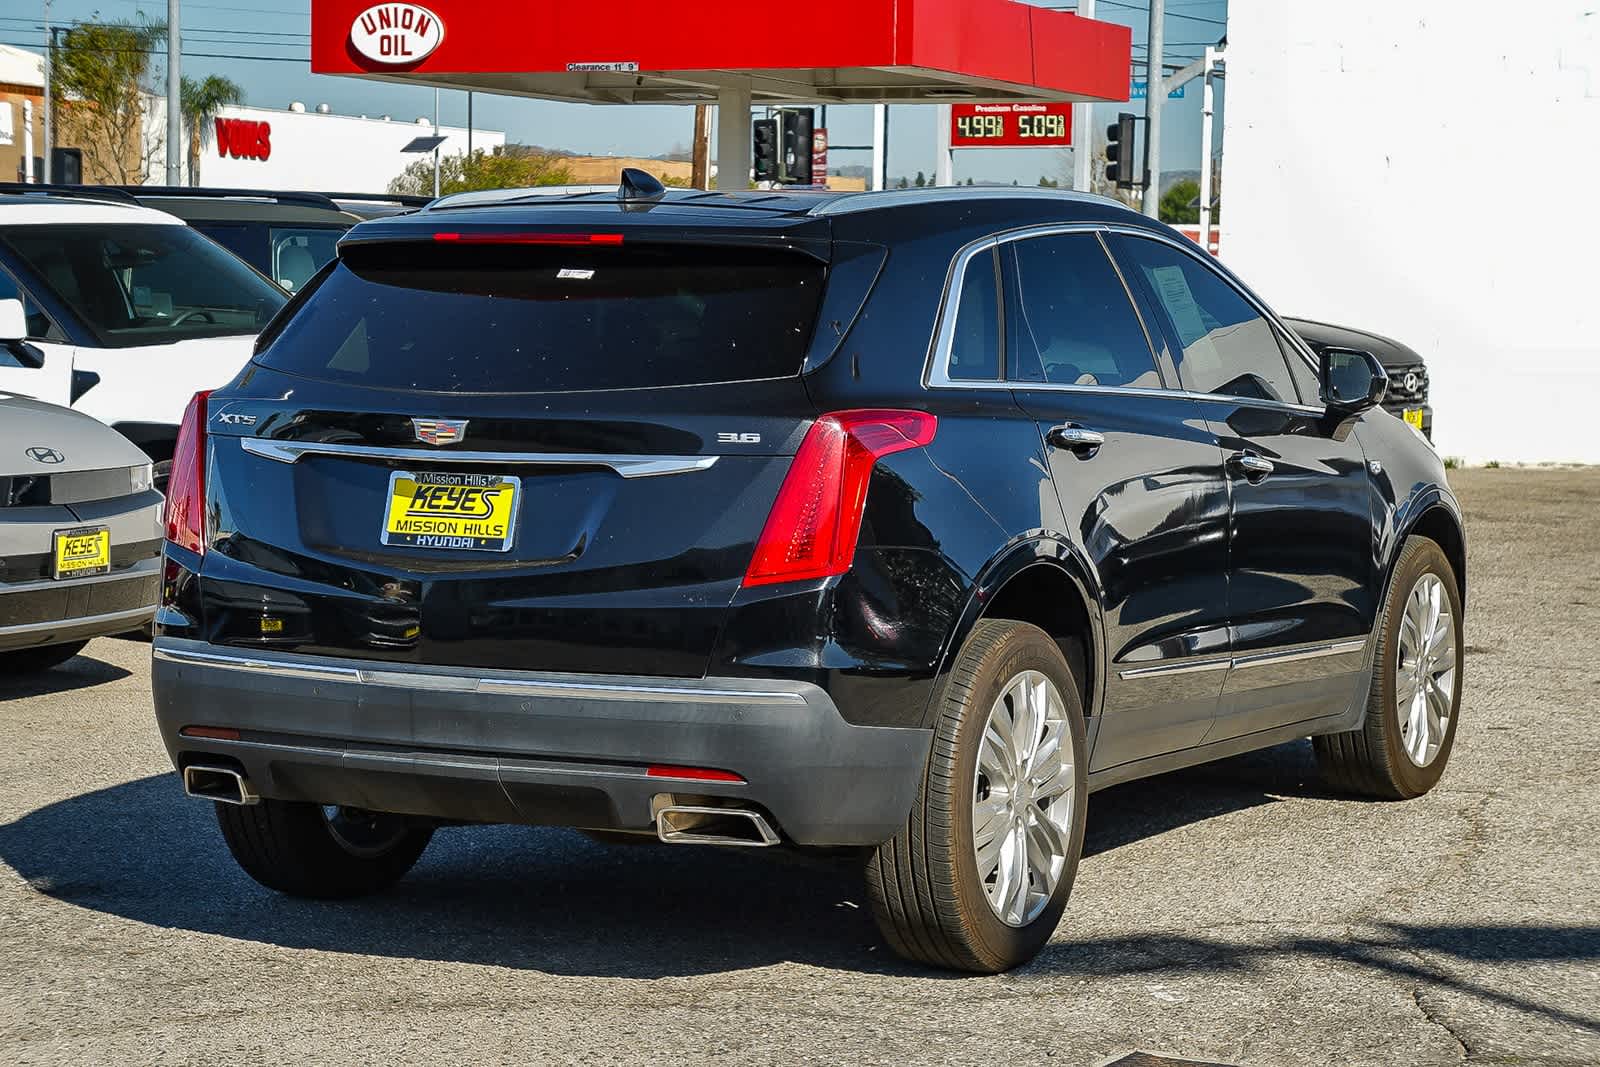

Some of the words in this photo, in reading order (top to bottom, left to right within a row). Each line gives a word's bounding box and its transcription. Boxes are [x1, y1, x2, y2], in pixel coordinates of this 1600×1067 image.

[360, 7, 431, 38] UNION
[380, 34, 413, 56] OIL
[567, 63, 611, 72] Clearance
[975, 104, 1011, 113] Premium
[1012, 103, 1047, 112] Gasoline
[214, 116, 271, 162] VONS
[423, 473, 462, 486] Mission
[464, 474, 487, 487] Hills
[406, 485, 502, 520] KEYES
[395, 519, 458, 535] MISSION
[463, 523, 504, 537] HILLS
[63, 535, 103, 561] KEYES
[416, 535, 474, 548] HYUNDAI
